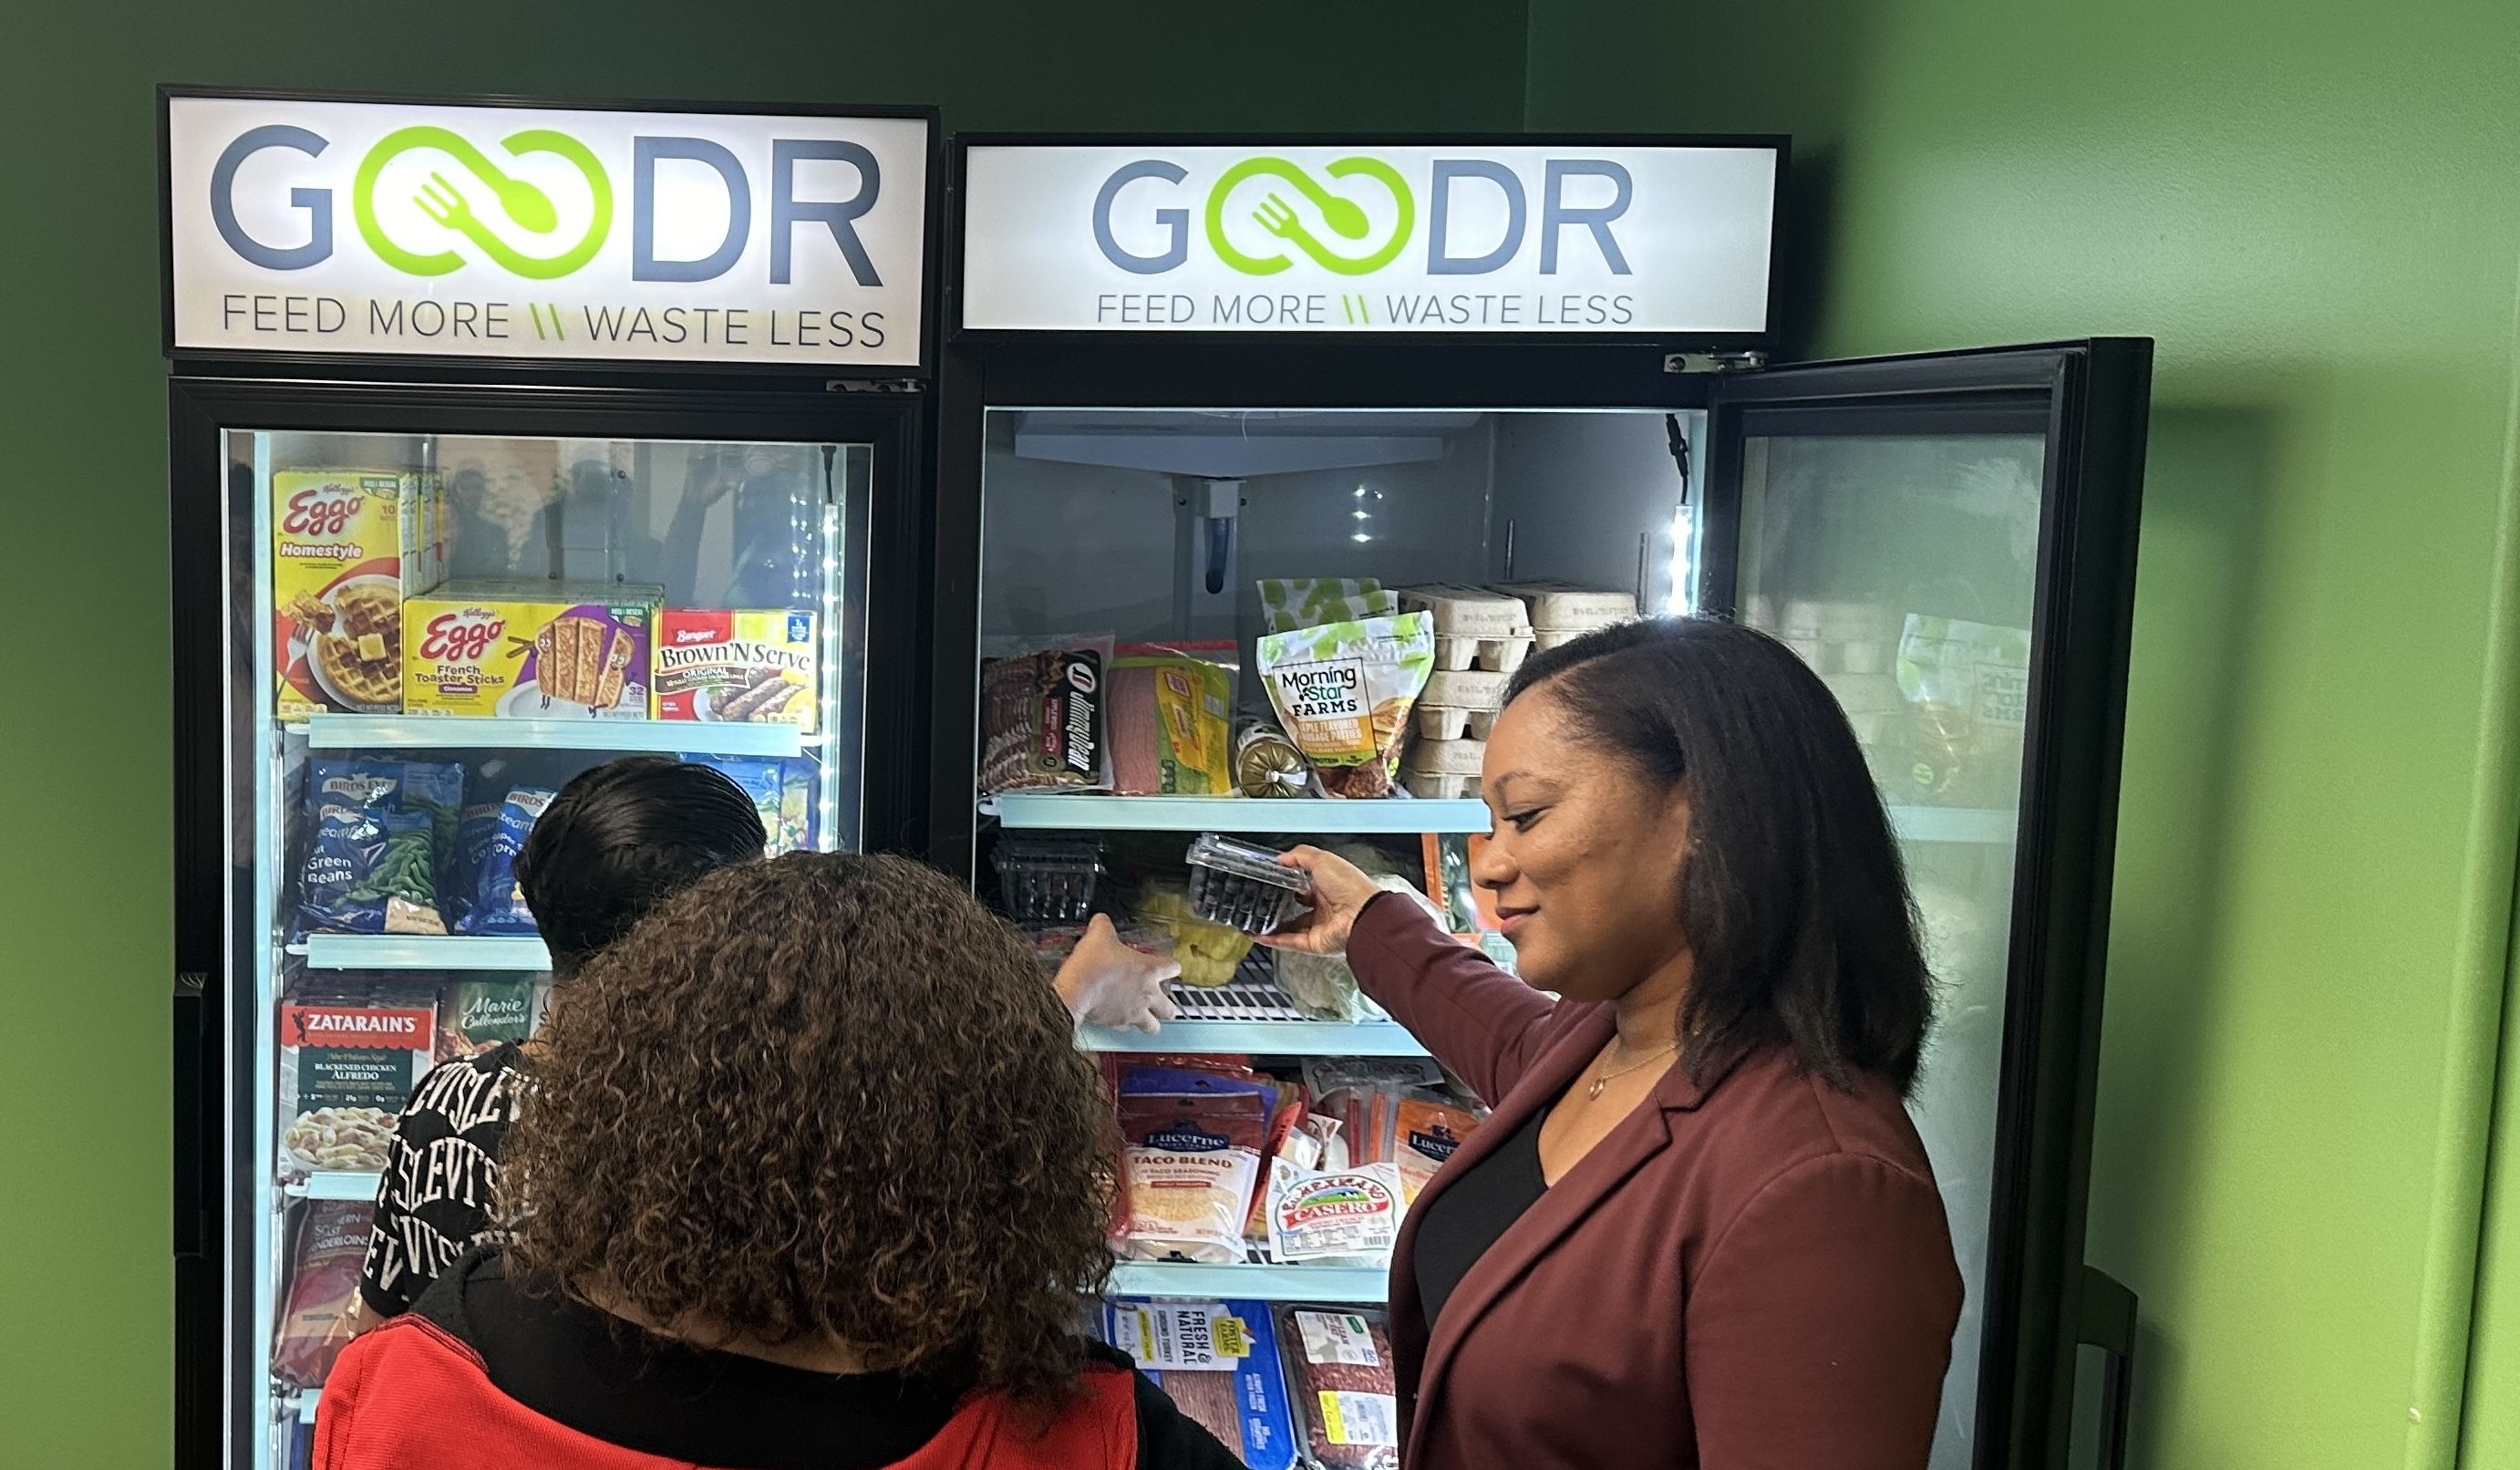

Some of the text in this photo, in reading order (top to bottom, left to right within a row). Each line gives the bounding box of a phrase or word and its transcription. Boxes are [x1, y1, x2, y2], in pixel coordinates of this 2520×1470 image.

[1097, 294, 1195, 324] FEED
[1213, 294, 1327, 325] MORE
[1386, 295, 1522, 325] WASTE
[1538, 295, 1635, 326] LESS
[222, 294, 346, 334] FEED
[369, 298, 511, 339] MORE
[584, 305, 749, 345] WASTE
[769, 309, 886, 348] LESS
[283, 489, 364, 536] Eggo
[280, 543, 364, 561] Homestyle
[419, 613, 506, 661] Eggo
[415, 673, 505, 685] Toaster Sticks
[438, 665, 481, 675] French
[683, 667, 729, 678] ORIGINAL
[1282, 666, 1357, 693] Morning
[1307, 685, 1343, 701] Star
[1292, 699, 1358, 718] FARMS
[330, 781, 366, 792] BIRDS
[510, 792, 547, 808] BIRDS
[307, 856, 353, 871] Green
[307, 869, 354, 885] Beans
[462, 997, 524, 1016] Marie
[307, 1013, 417, 1033] ZATARAIN'S
[314, 1062, 398, 1072] BLACKENED CHICKEN
[331, 1070, 381, 1082] ALFREDO
[1149, 1133, 1225, 1147] Lucerne
[1133, 1155, 1233, 1169] TACO BLEND
[1293, 1202, 1379, 1223] CASERO
[1157, 1310, 1173, 1363] GROUND TURKEY
[1176, 1310, 1198, 1365] NATURAL
[1192, 1310, 1213, 1364] FRESH &
